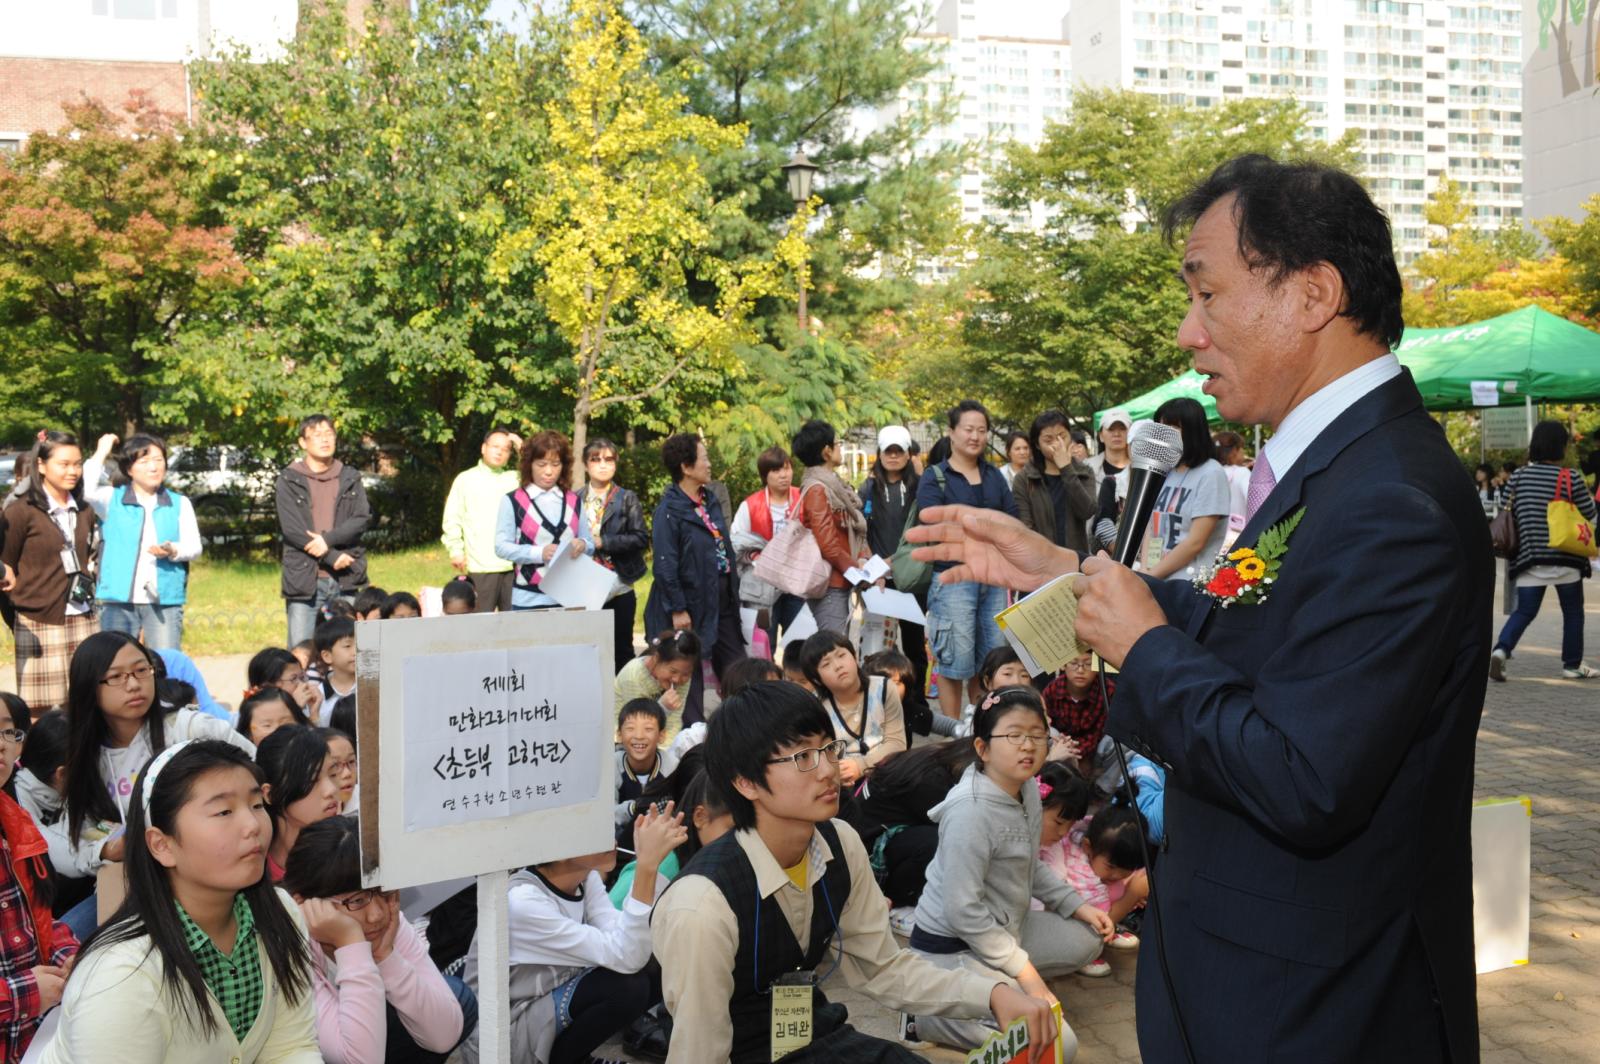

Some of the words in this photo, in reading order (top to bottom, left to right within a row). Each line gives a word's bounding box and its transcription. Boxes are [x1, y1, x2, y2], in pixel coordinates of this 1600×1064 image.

[482, 668, 525, 694] 제11회
[449, 698, 557, 733] 만화그리기대회
[775, 1020, 810, 1039] 김태완
